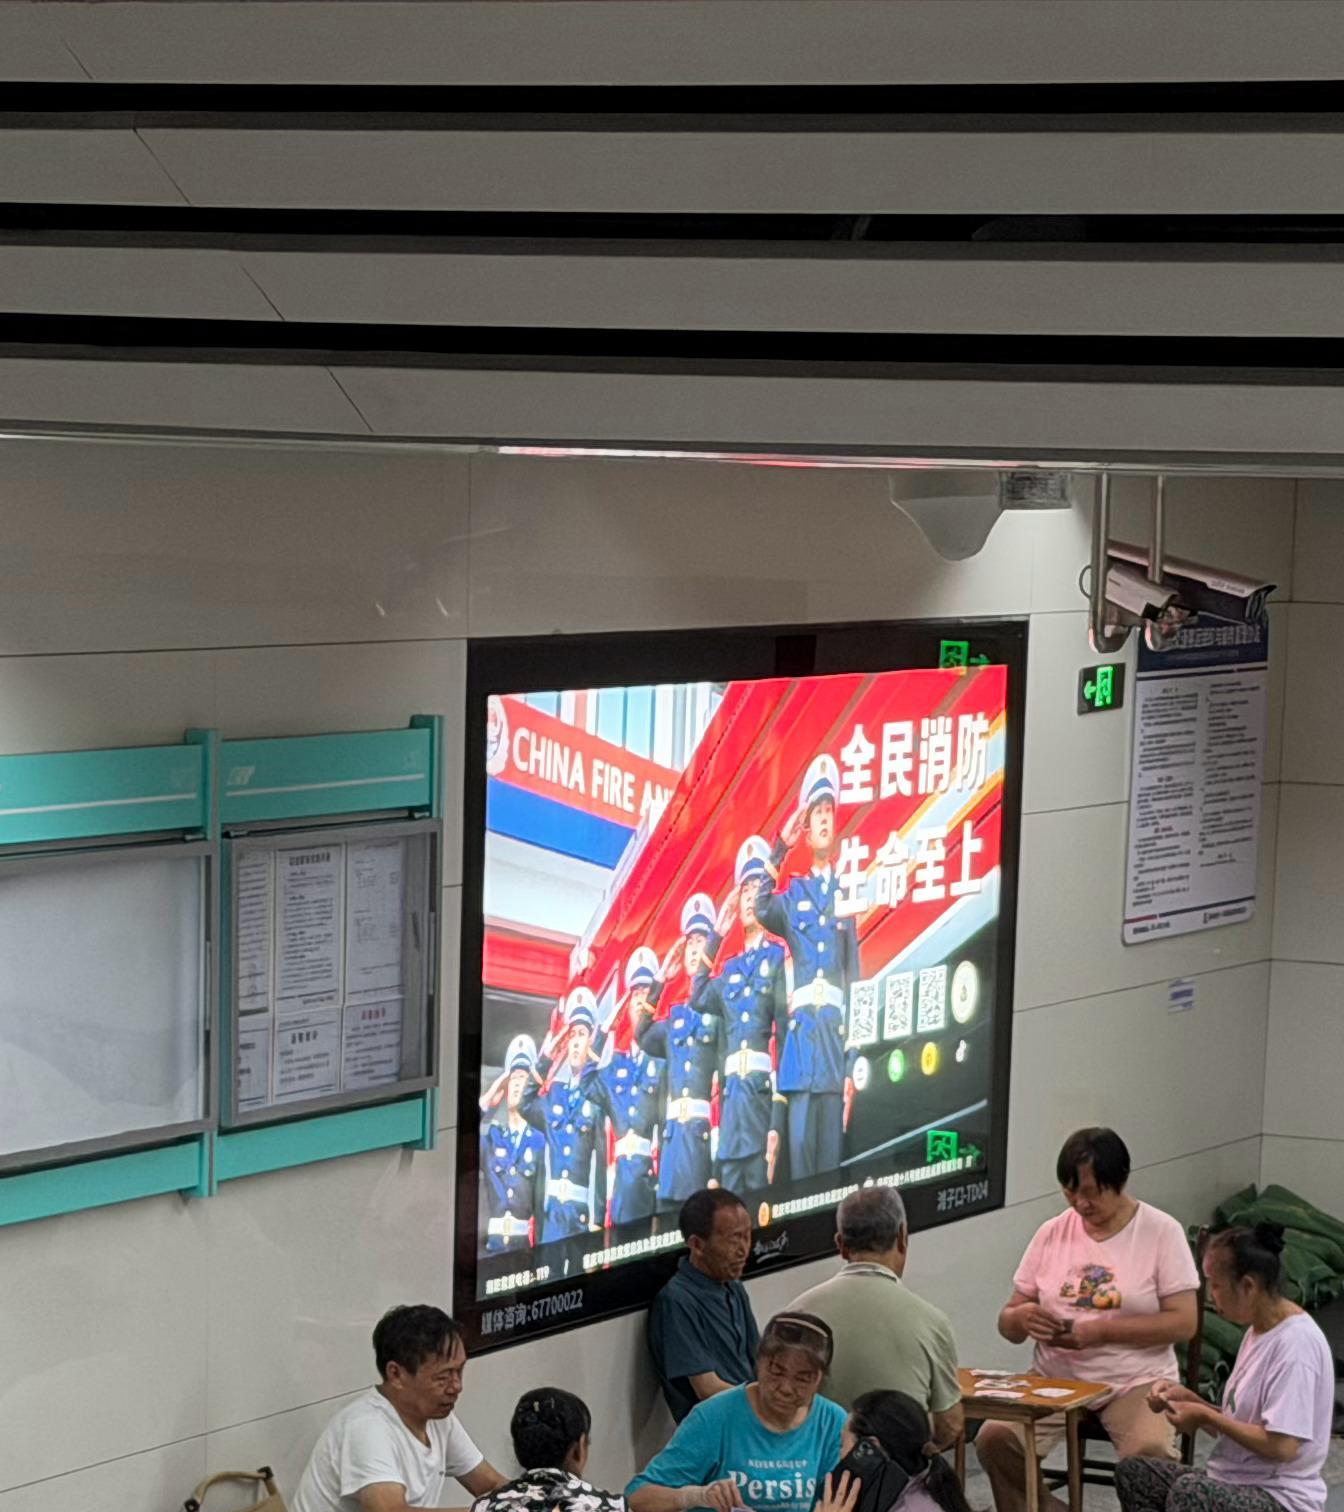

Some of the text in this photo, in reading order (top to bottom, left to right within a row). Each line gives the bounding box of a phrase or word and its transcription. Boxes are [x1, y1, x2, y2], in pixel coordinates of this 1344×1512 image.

[512, 727, 675, 816] CHINA FIRE AN
[839, 712, 990, 804] 全民消防
[833, 821, 984, 918] 生命至上
[727, 1470, 816, 1500] Persis
